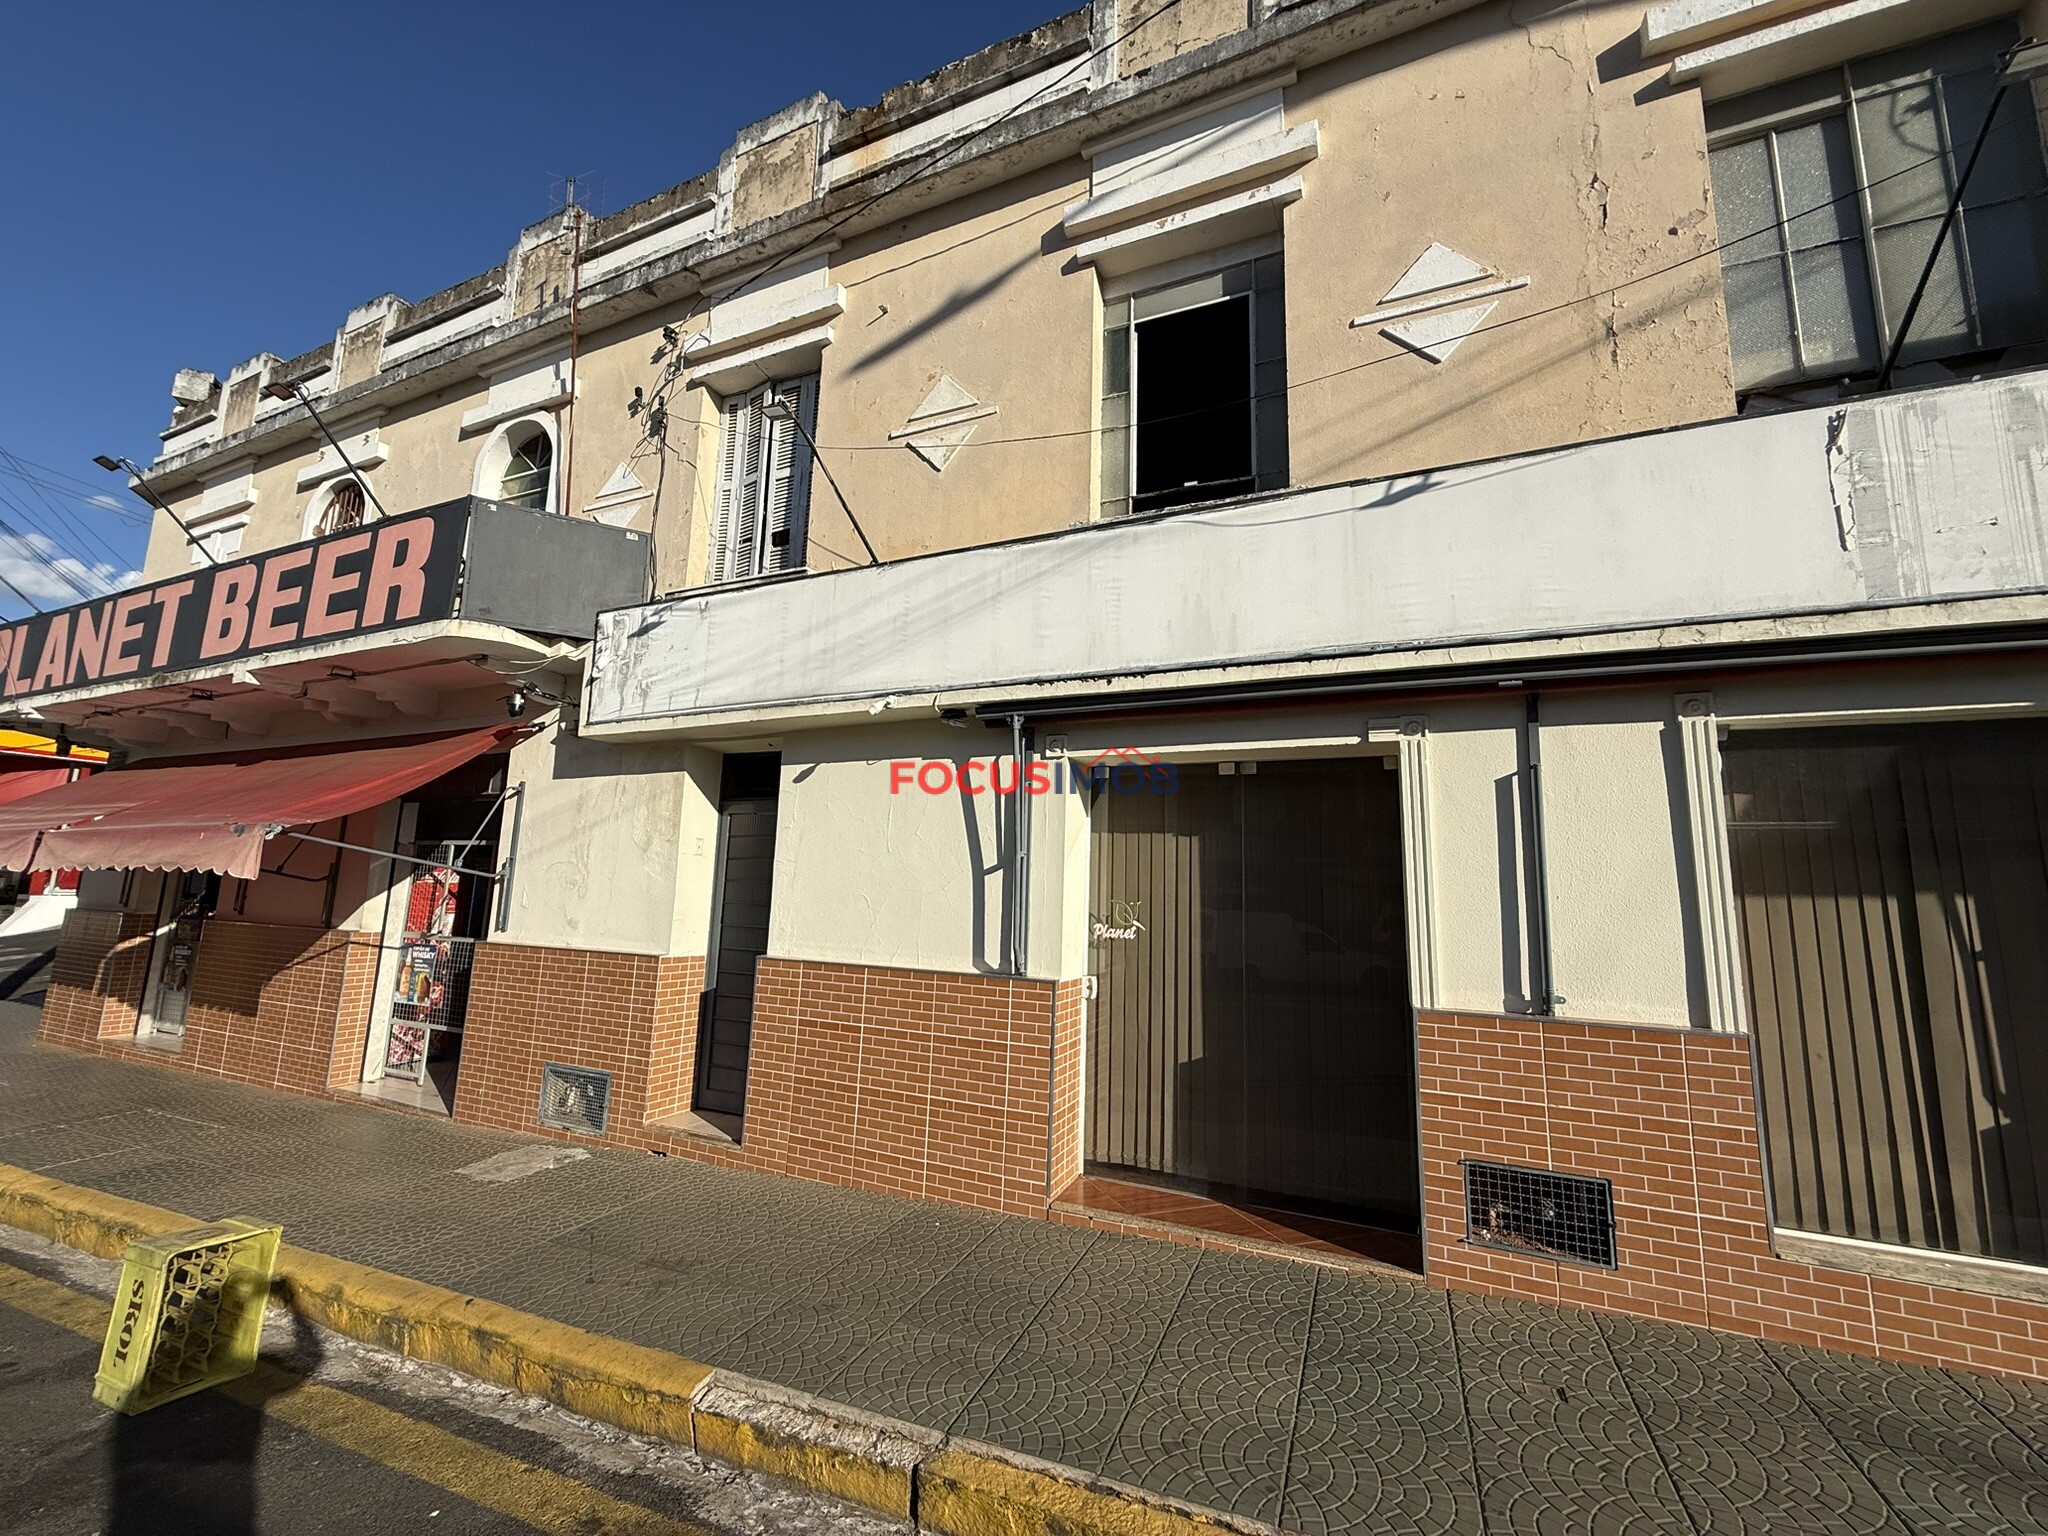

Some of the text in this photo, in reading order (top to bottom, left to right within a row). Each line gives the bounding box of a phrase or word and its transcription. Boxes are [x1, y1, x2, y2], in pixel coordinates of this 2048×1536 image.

[200, 516, 435, 659] BEER
[412, 950, 435, 959] WHISKY
[1093, 923, 1137, 940] Planet
[113, 1279, 144, 1367] SKOL
